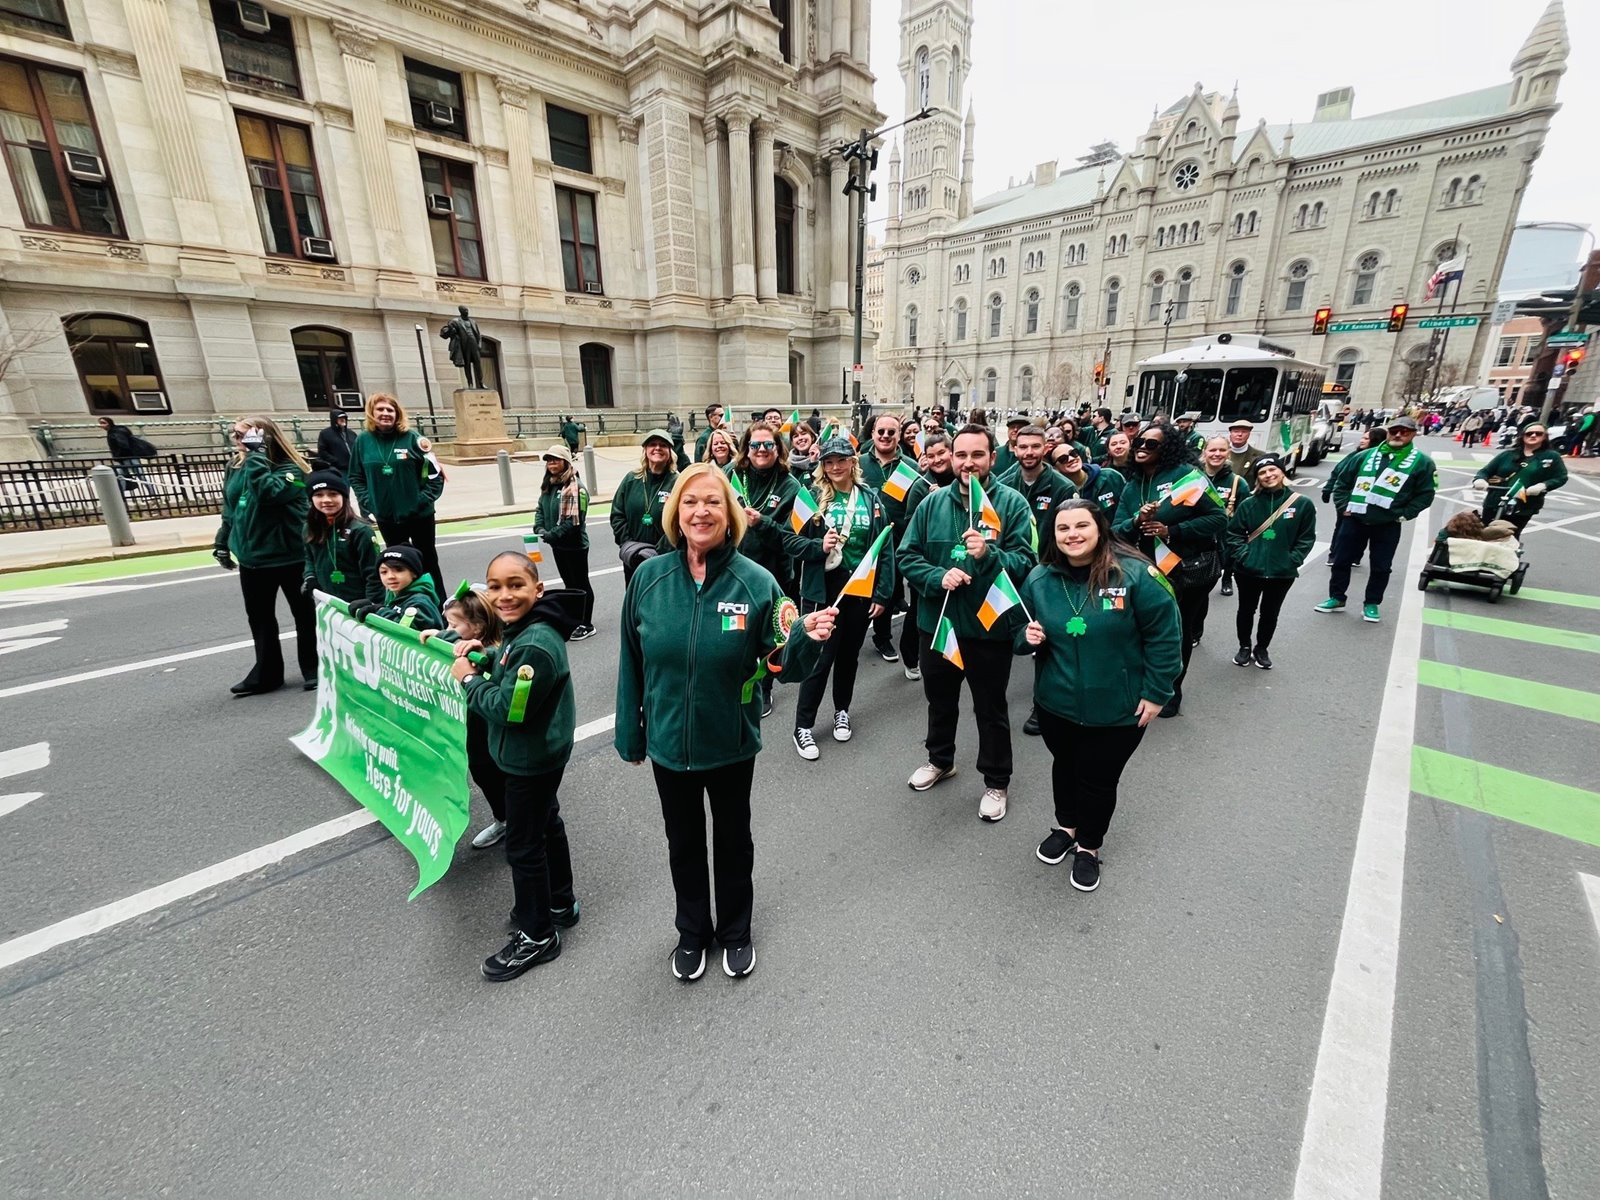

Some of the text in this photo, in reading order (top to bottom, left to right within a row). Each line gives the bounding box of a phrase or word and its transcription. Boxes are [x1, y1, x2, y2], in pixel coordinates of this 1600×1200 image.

[1421, 320, 1451, 328] Filbert
[717, 602, 749, 615] PFCU
[380, 636, 465, 700] PHILADELPHIA
[406, 677, 437, 706] CREDIT
[437, 691, 465, 724] UNION
[365, 752, 391, 799] Here
[392, 774, 412, 816] for
